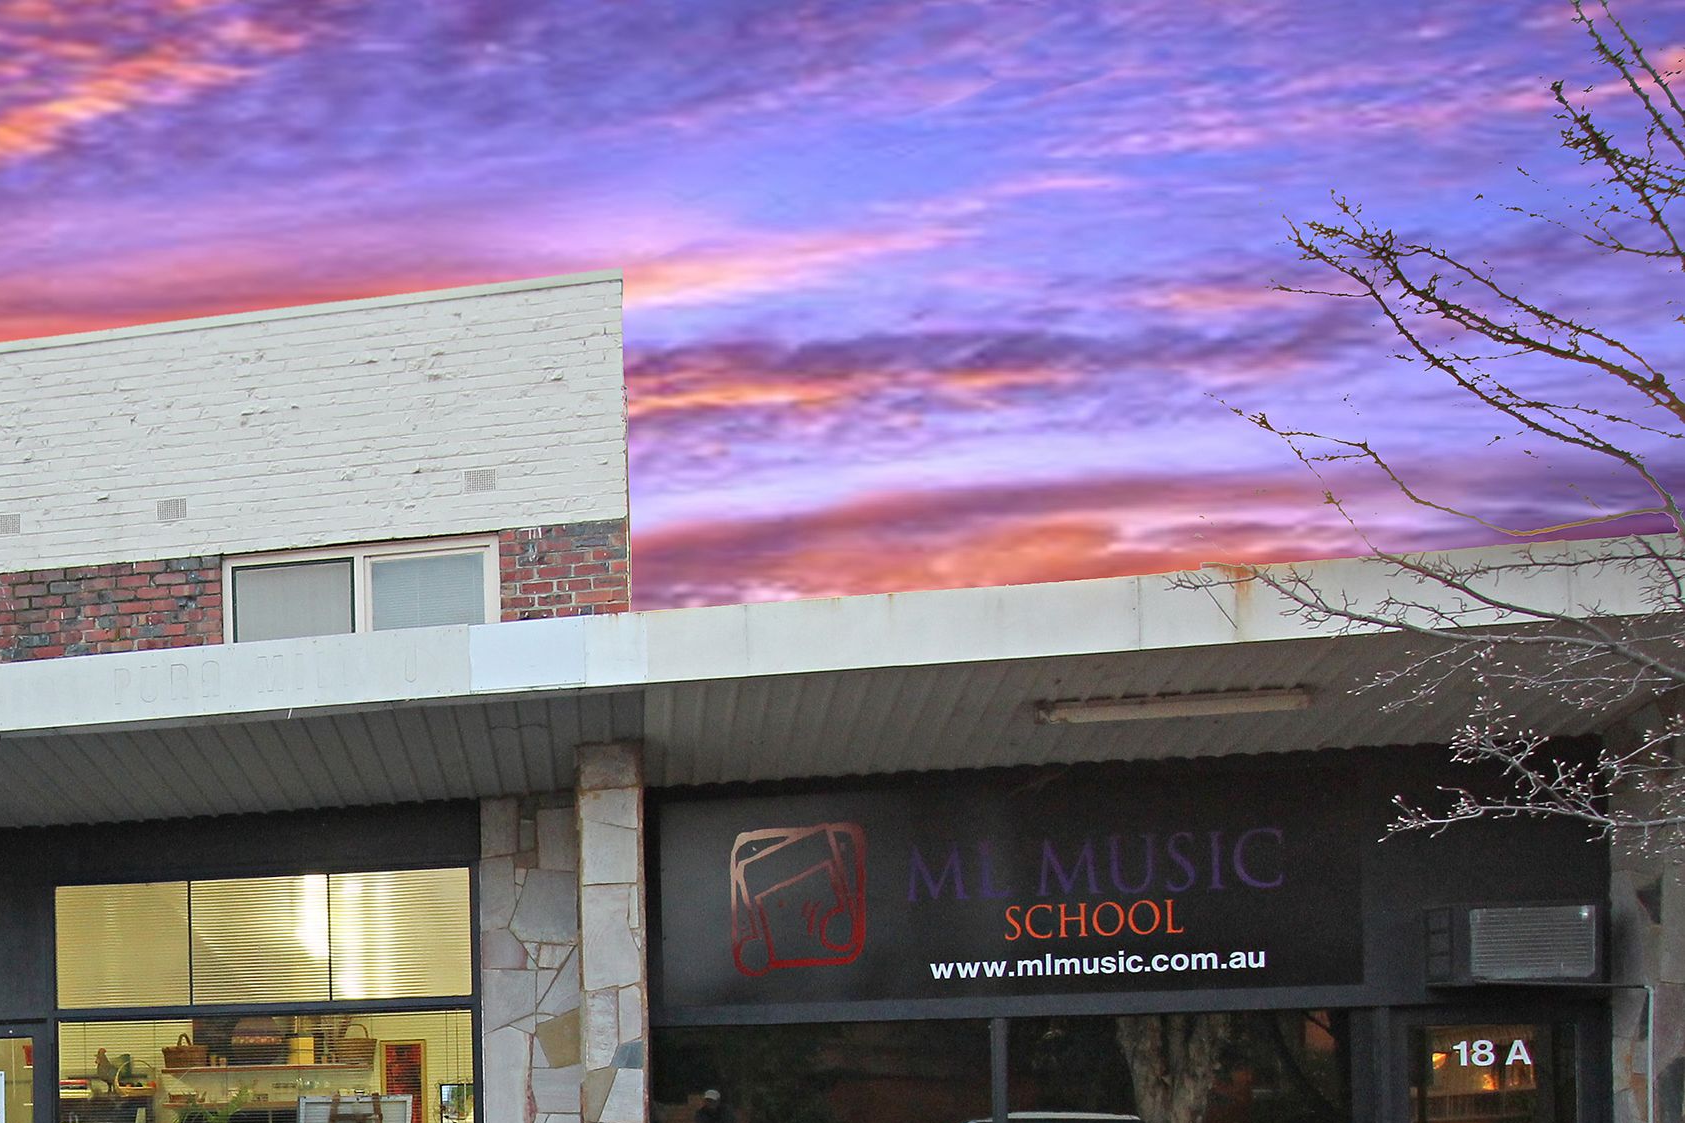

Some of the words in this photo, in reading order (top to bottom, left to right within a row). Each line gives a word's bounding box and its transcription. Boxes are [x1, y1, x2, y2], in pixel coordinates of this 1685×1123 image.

[907, 839, 1012, 900] ML
[1036, 827, 1285, 897] MUSIC
[1005, 899, 1184, 941] SCHOOL
[930, 950, 1266, 980] www.mlmusic.com.au
[1452, 1039, 1495, 1067] 18
[1505, 1039, 1532, 1066] A
